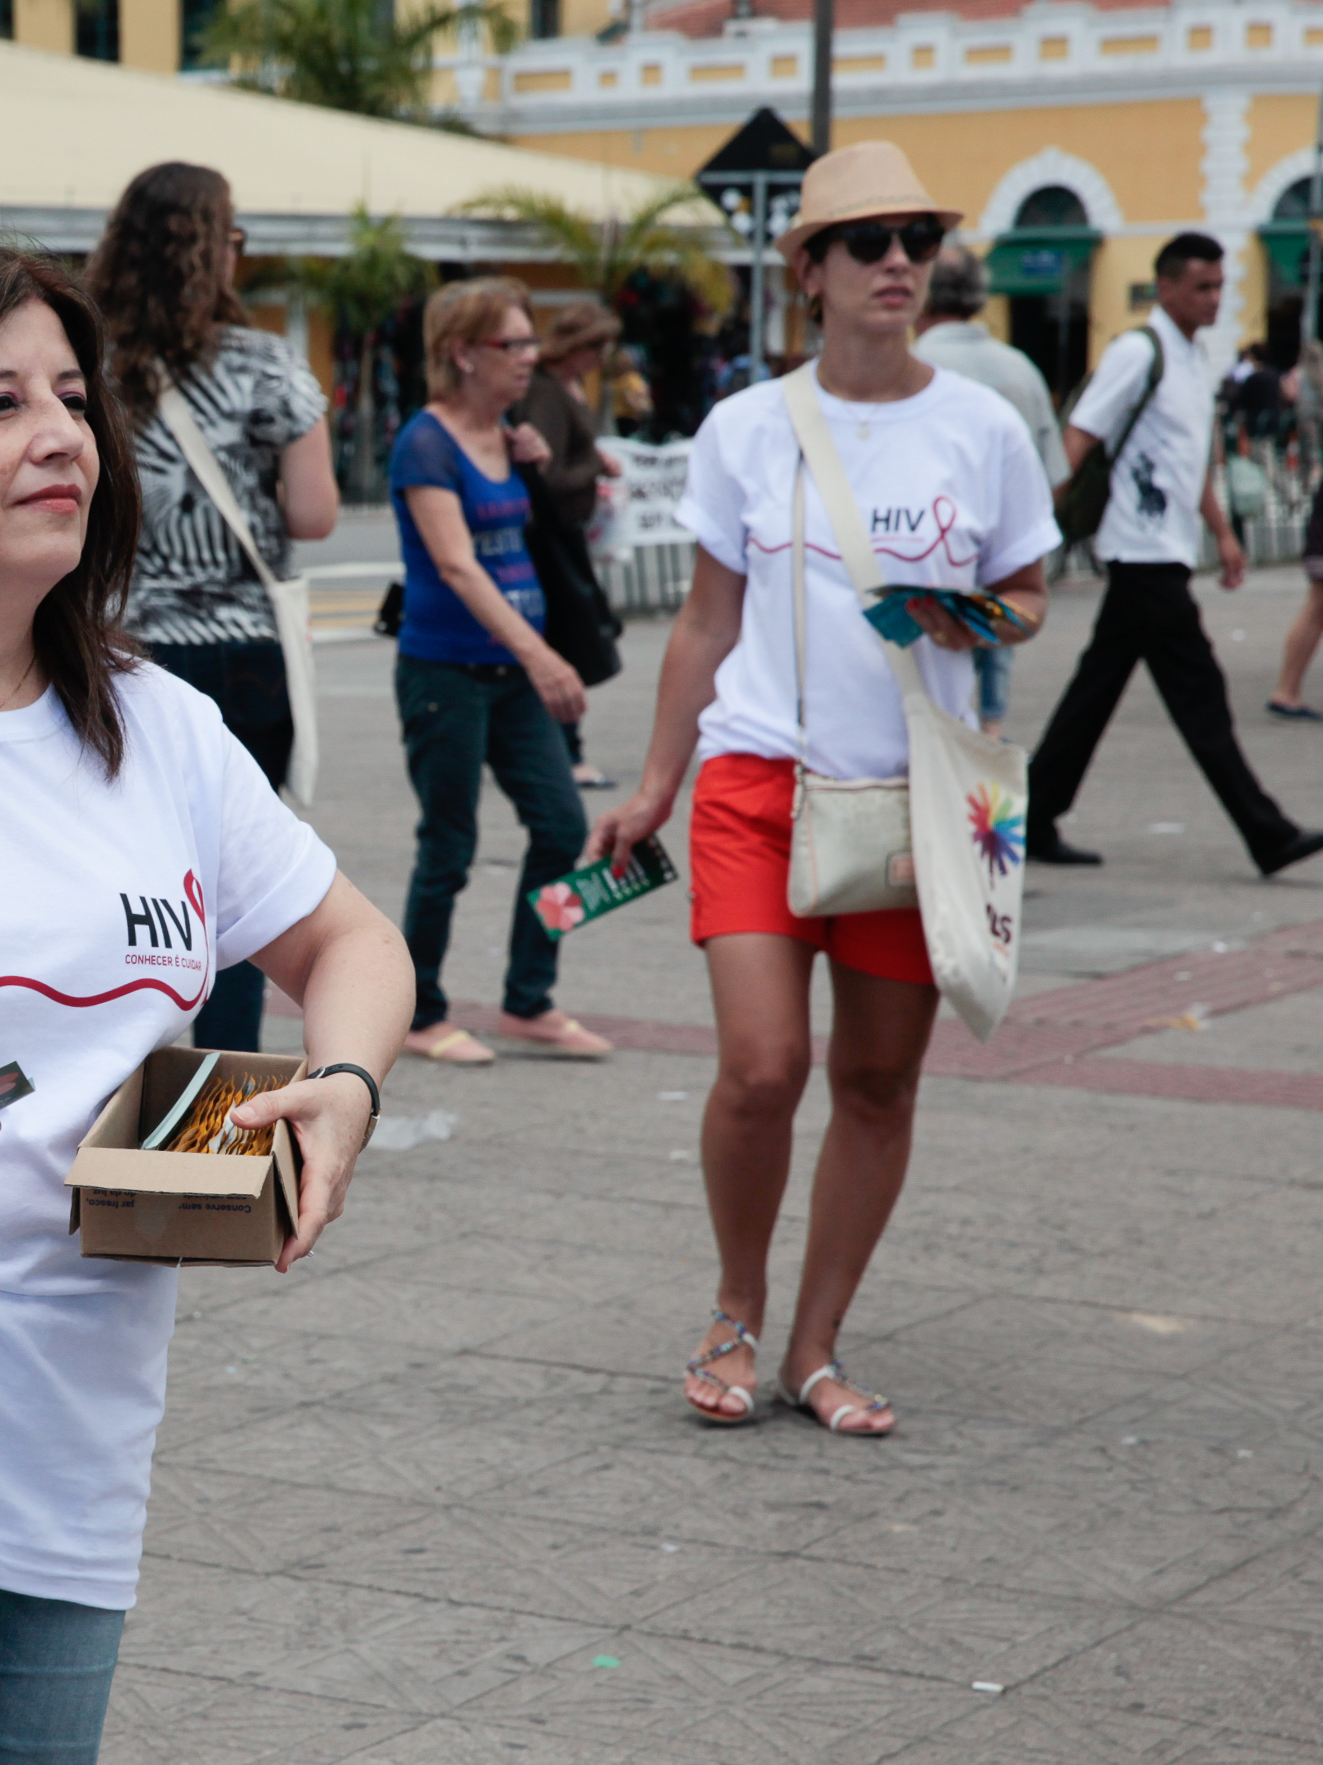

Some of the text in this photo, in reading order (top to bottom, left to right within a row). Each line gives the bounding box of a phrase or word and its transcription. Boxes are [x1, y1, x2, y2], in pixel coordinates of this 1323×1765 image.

[871, 508, 925, 532] HIV
[119, 892, 192, 951] HIV
[125, 954, 173, 966] CONHECER
[175, 954, 180, 967] É
[86, 1198, 119, 1208] fresco,
[205, 1203, 252, 1214] Conserve
